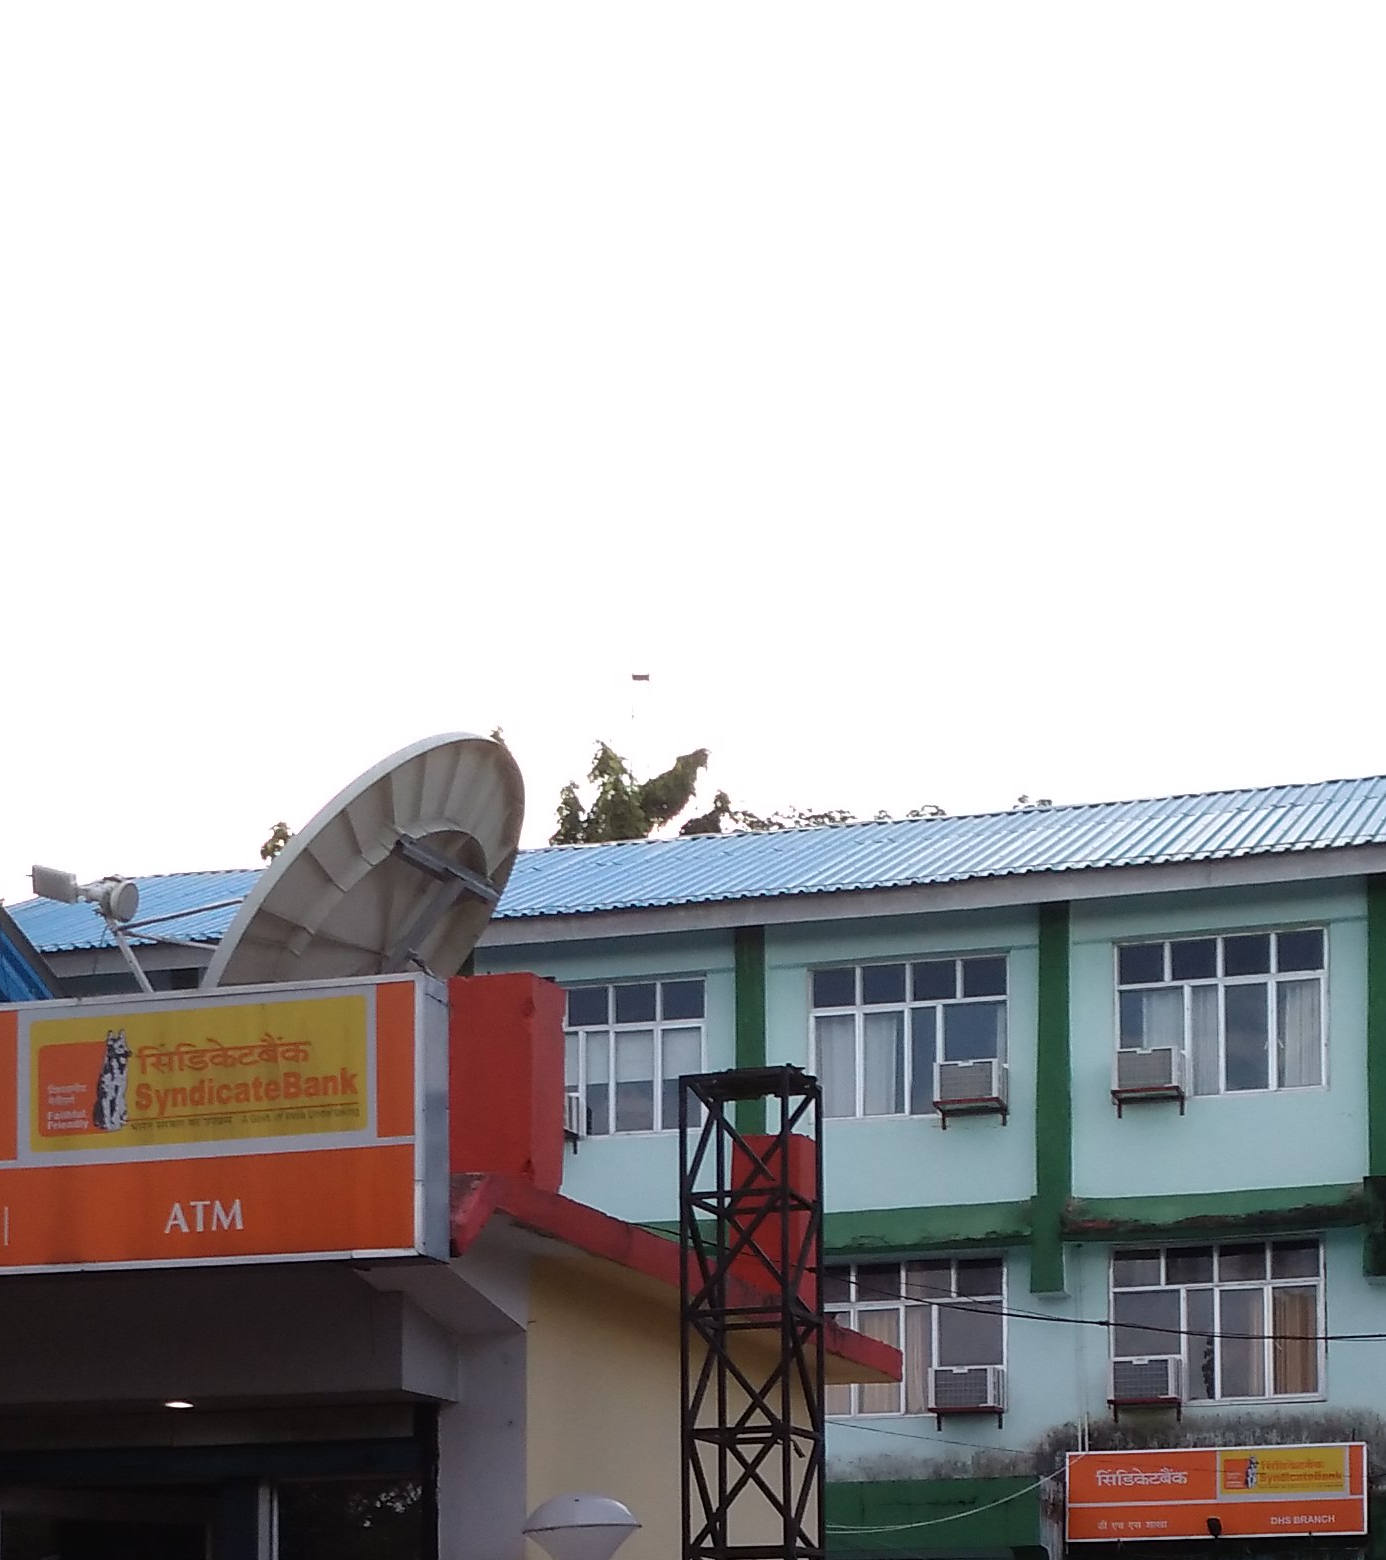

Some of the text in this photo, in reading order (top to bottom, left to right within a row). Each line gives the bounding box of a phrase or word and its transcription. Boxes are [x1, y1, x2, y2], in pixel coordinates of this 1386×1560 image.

[135, 1067, 359, 1118] SyndicateBank
[164, 1199, 245, 1234] ATM
[1270, 1514, 1335, 1525] DHS BRANCH
